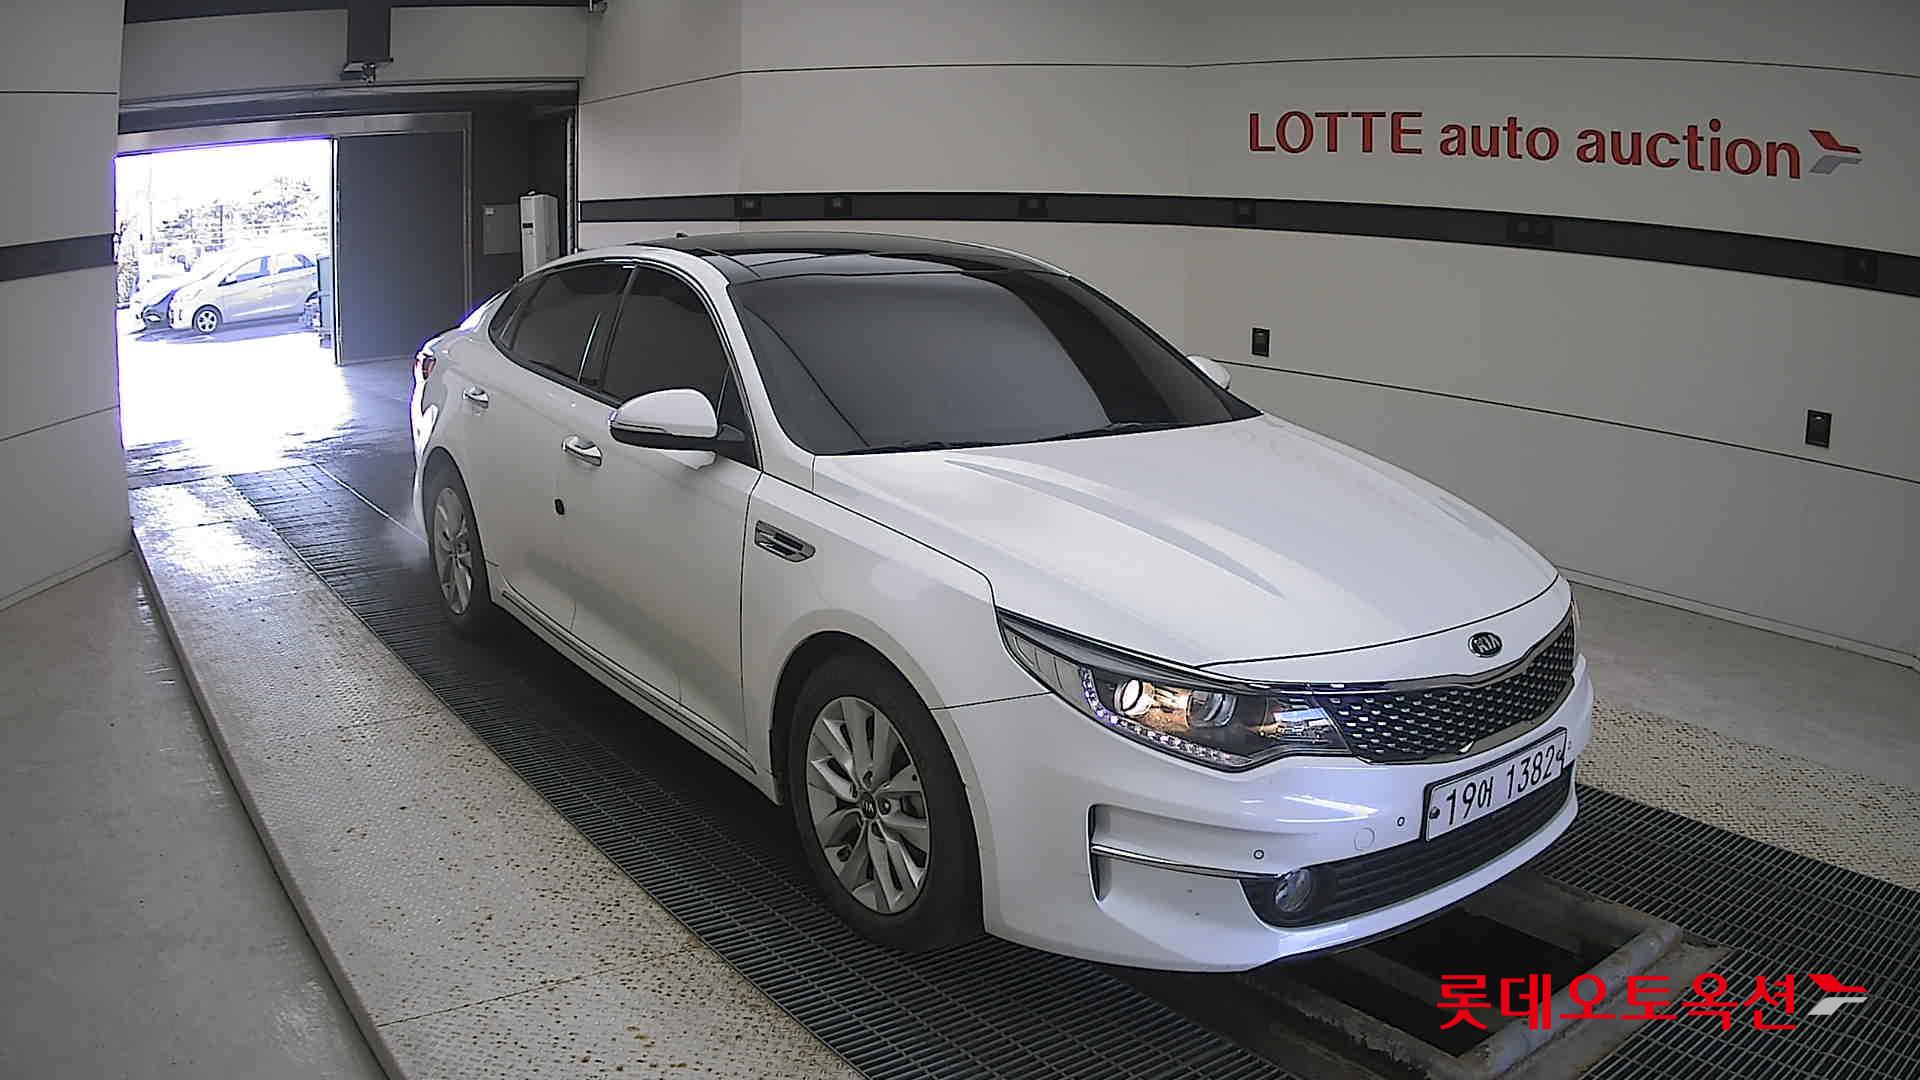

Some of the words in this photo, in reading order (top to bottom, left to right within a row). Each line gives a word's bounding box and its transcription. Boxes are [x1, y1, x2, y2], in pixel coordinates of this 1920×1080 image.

[1248, 110, 1424, 155] LOTTE
[1438, 115, 1560, 160] auto
[1576, 118, 1802, 179] auction
[1446, 776, 1494, 825] 19어
[1506, 745, 1555, 799] 1382
